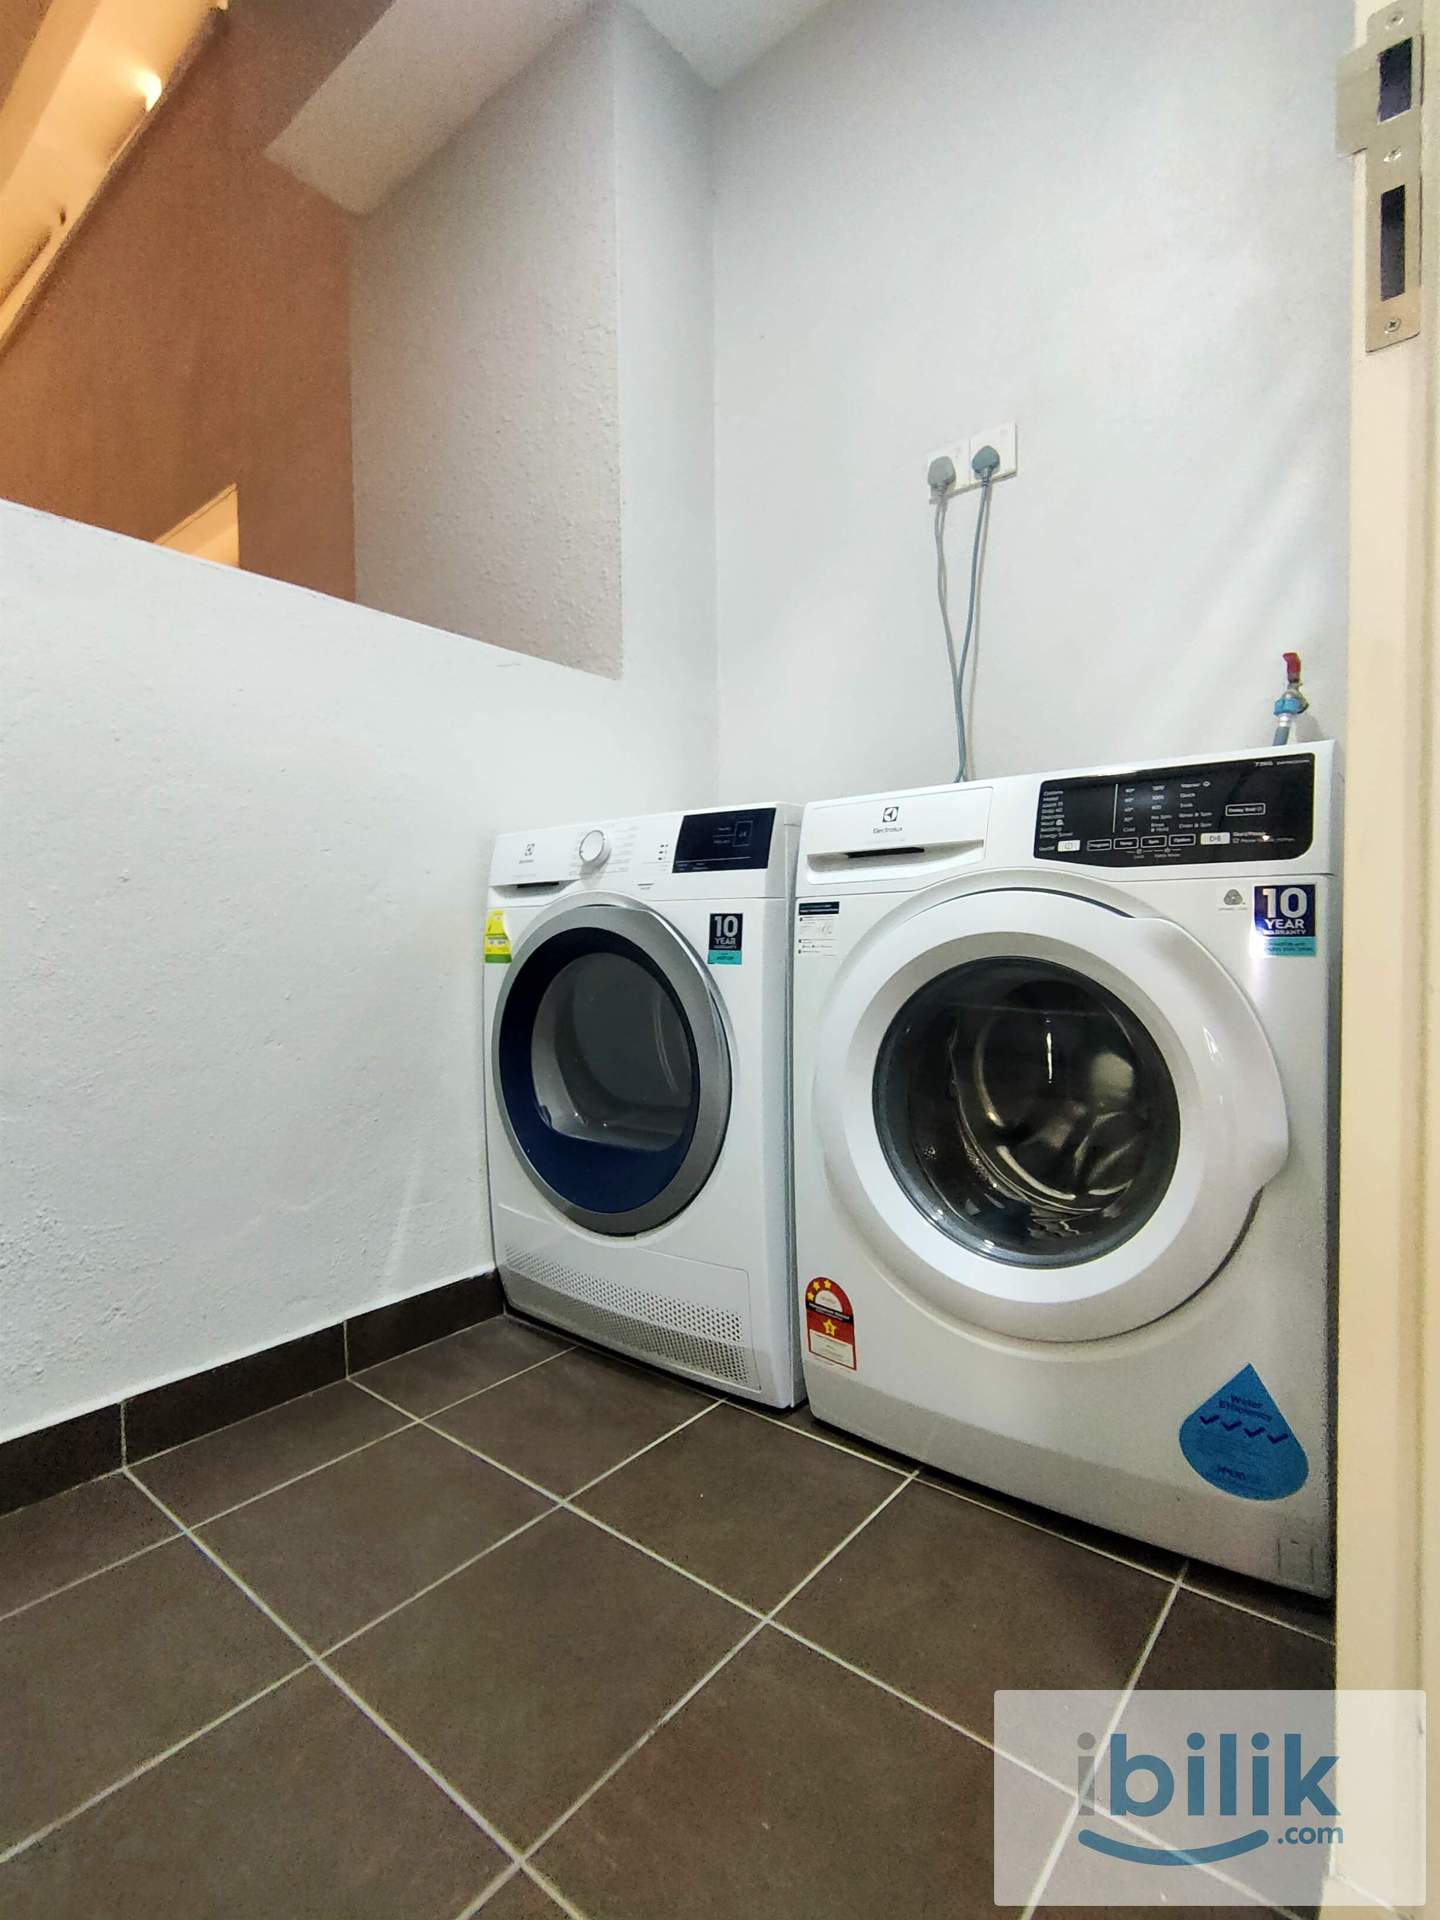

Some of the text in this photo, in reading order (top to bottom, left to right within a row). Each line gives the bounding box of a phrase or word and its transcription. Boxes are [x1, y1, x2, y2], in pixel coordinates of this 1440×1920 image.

[1263, 887, 1308, 919] 10
[714, 915, 739, 938] 10
[1264, 918, 1305, 930] YEAR
[714, 937, 736, 945] YEAR
